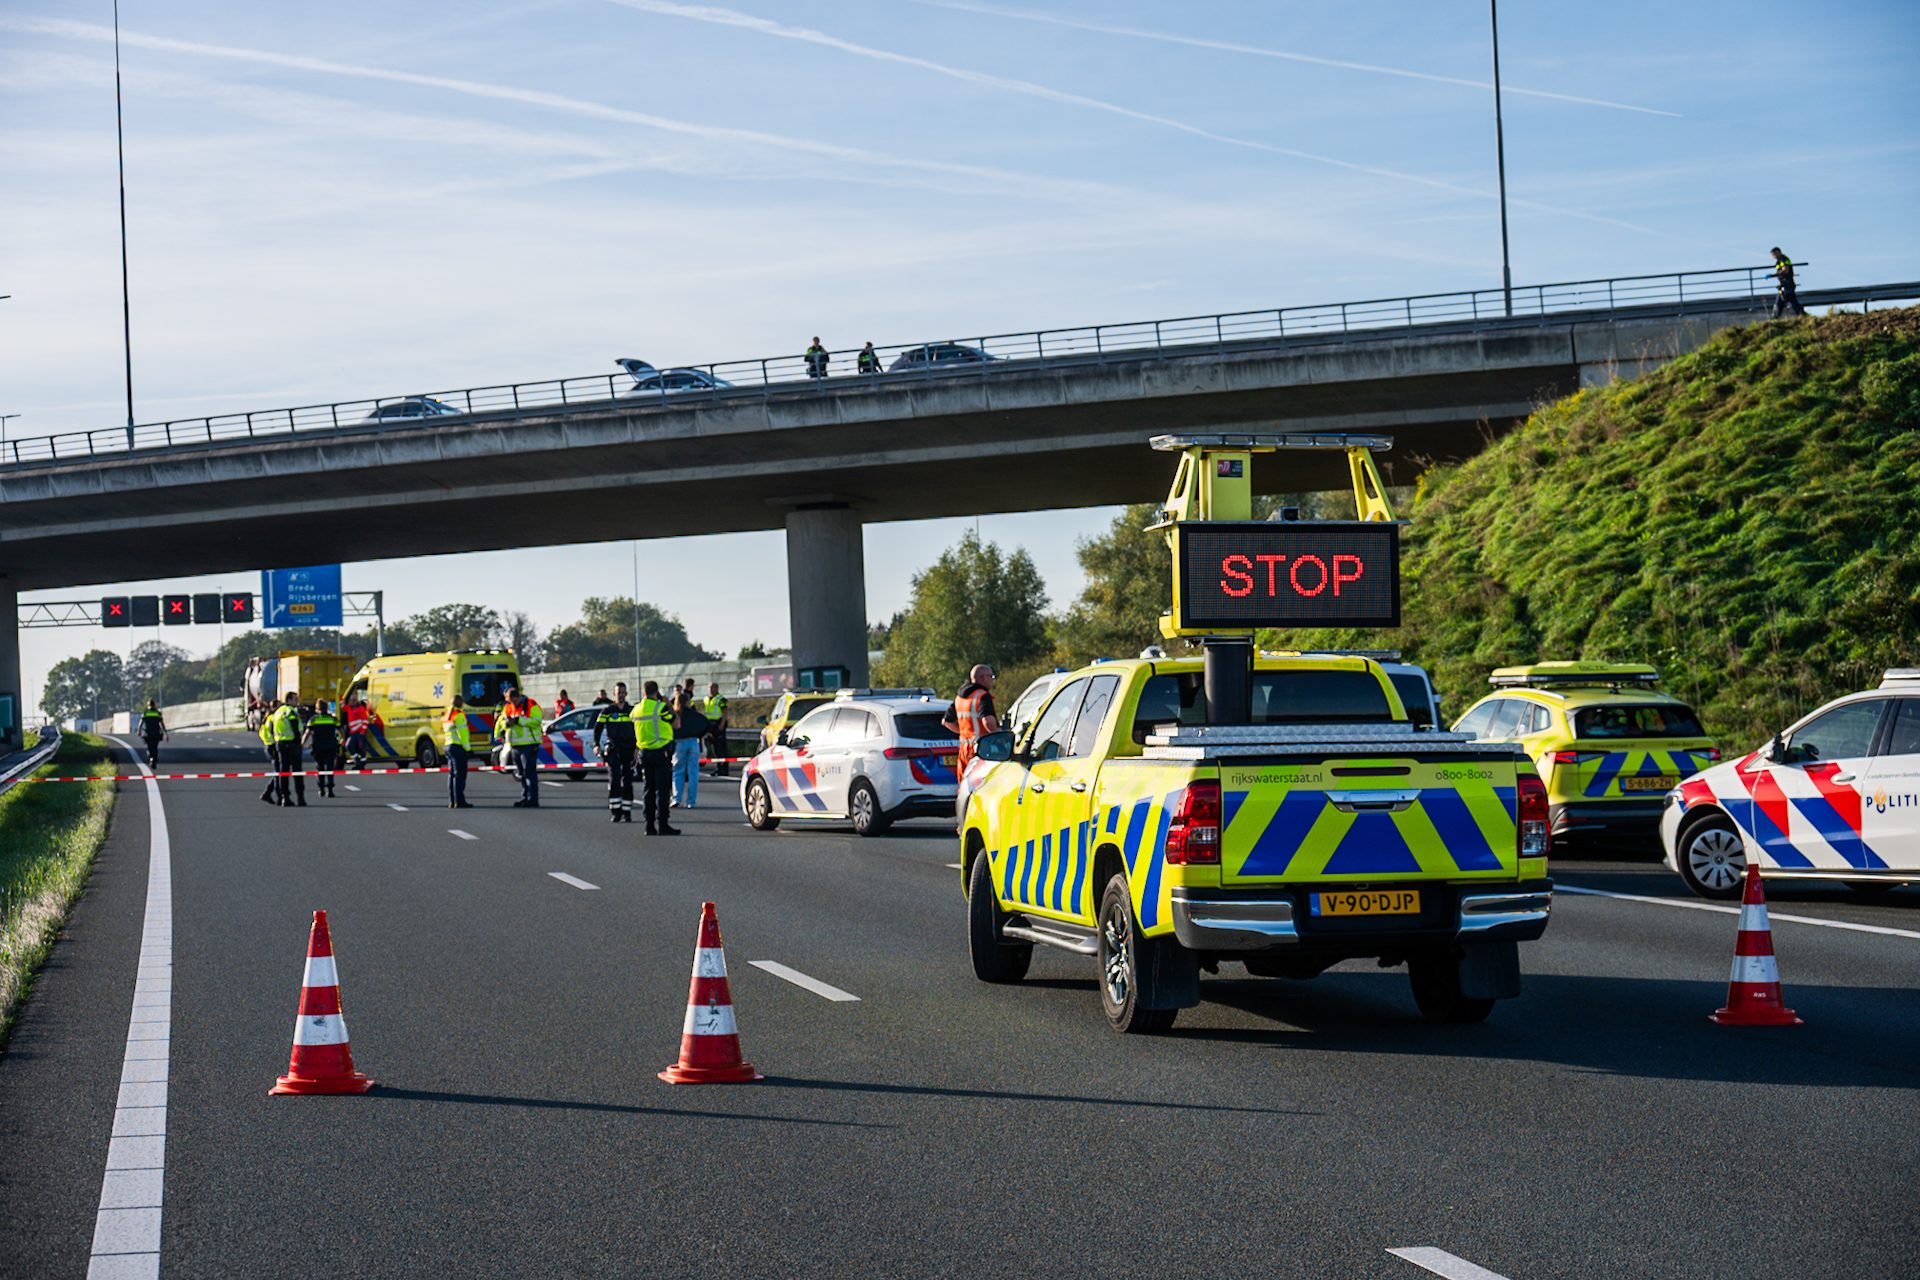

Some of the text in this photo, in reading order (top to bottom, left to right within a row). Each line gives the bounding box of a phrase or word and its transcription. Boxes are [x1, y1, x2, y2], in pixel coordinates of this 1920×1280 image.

[1220, 555, 1363, 597] STOP
[288, 584, 315, 592] Breda
[288, 594, 337, 603] Rijsbergen
[1231, 772, 1323, 785] rijkswaterstaat.nl
[1435, 770, 1494, 780] 0800-8002
[1326, 893, 1414, 912] V-90-DJP
